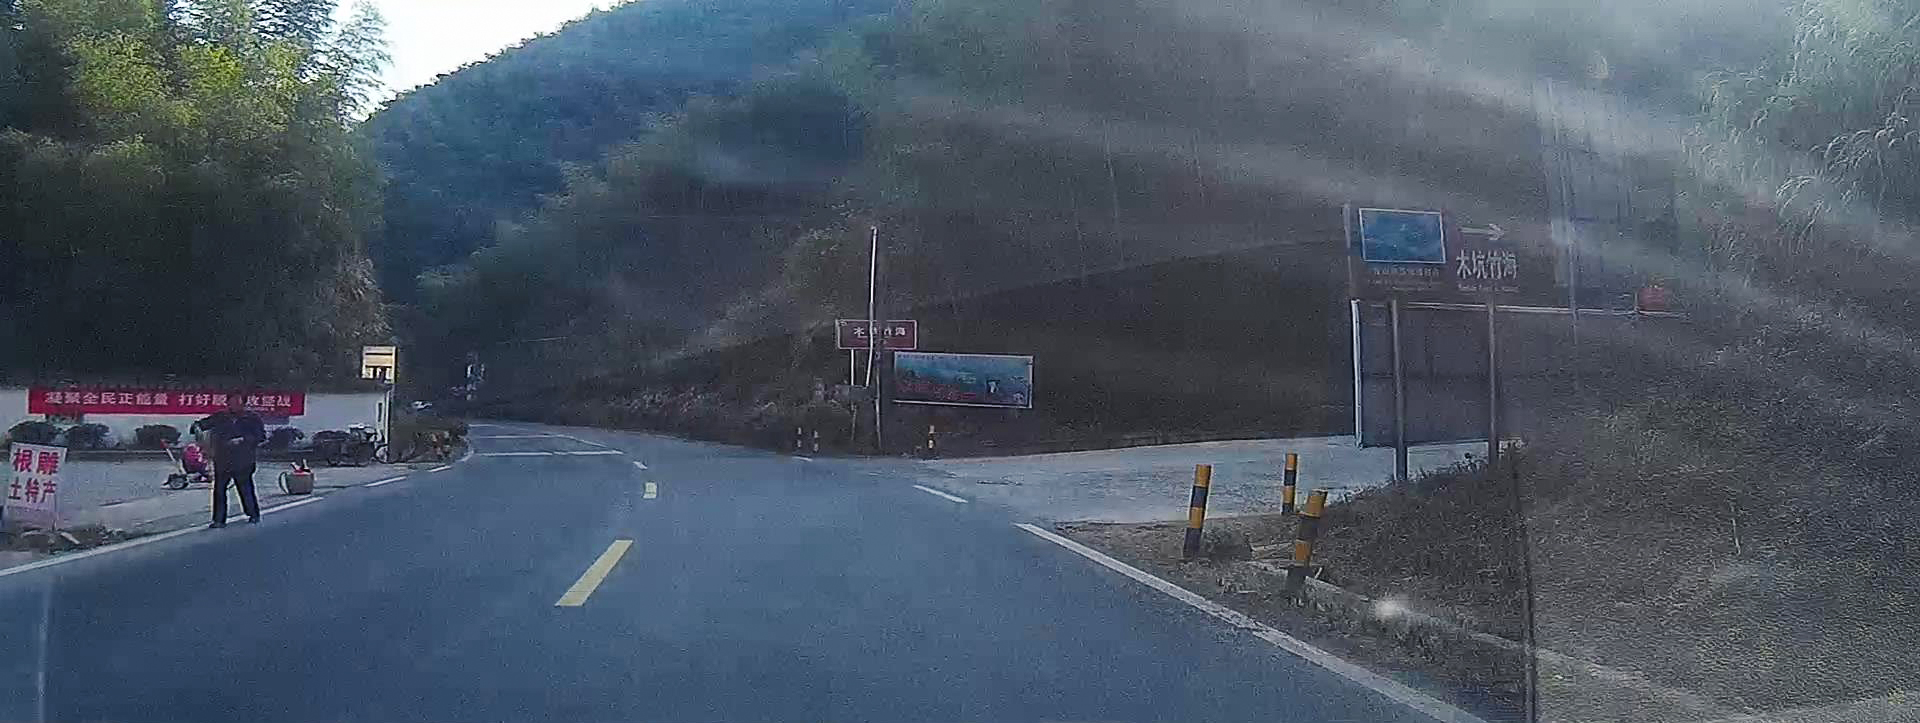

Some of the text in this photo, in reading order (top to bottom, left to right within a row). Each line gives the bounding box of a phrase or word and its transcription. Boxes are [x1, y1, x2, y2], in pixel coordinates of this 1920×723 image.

[1456, 249, 1517, 279] 木坑竹海
[44, 391, 291, 407] 凝聚全民正能量 打好脱攻坚战
[13, 448, 59, 475] 根雕
[8, 477, 57, 503] 土特产
